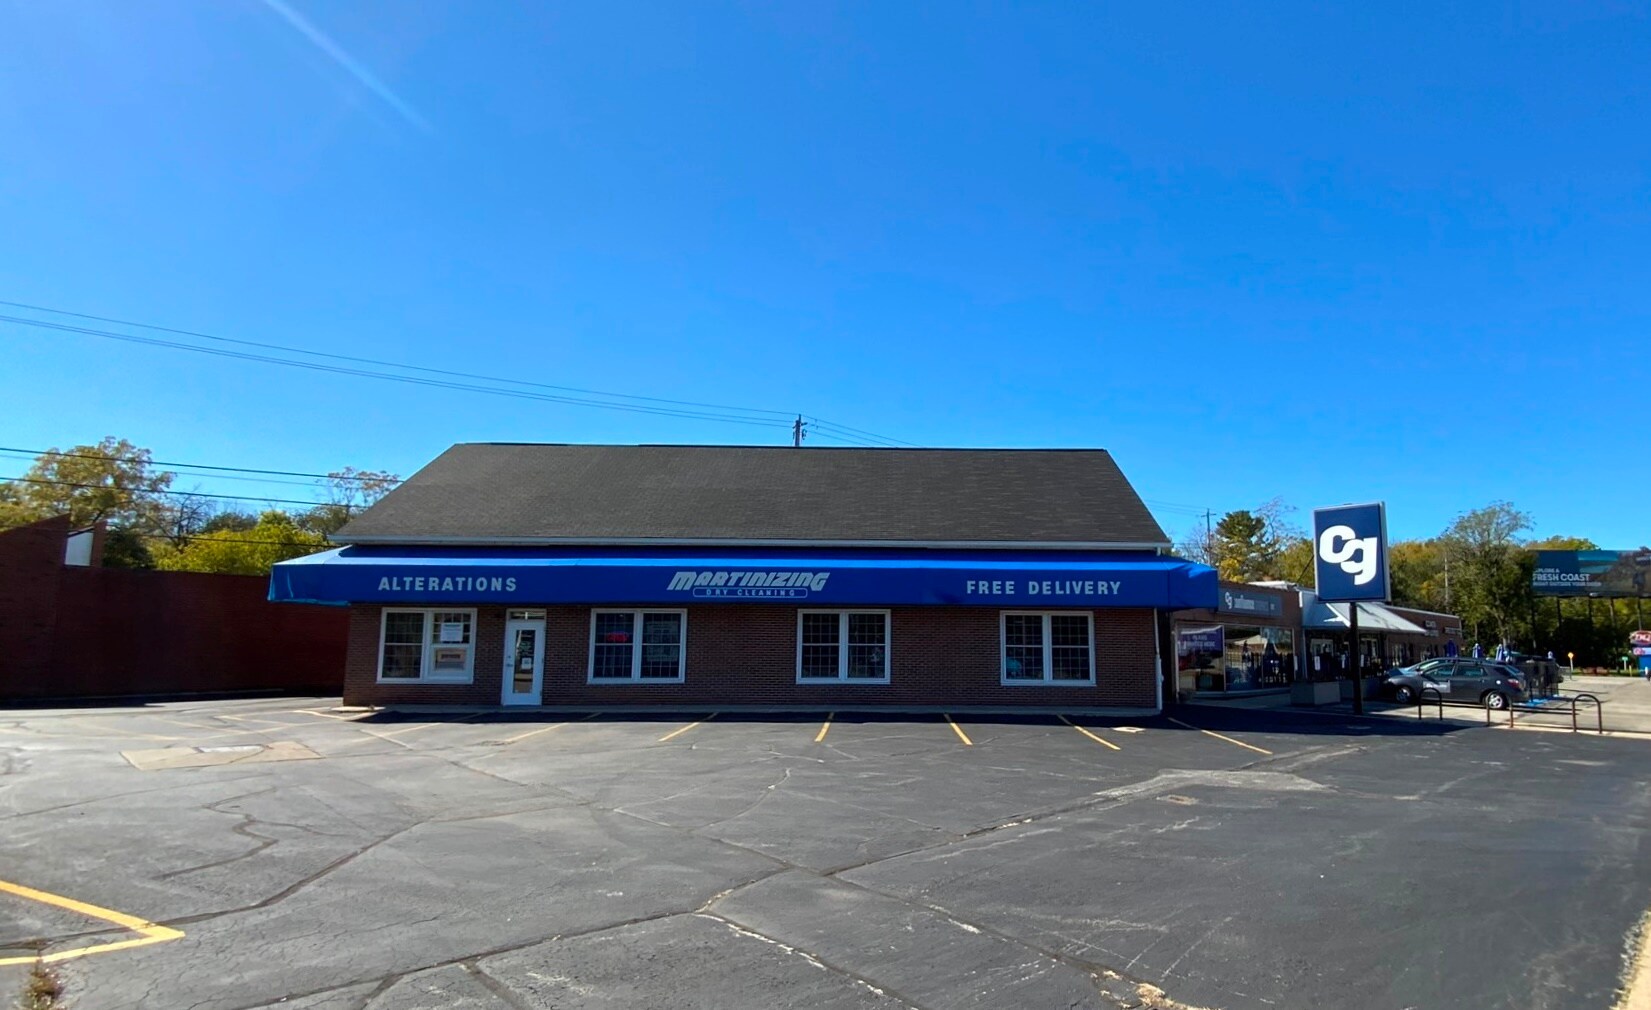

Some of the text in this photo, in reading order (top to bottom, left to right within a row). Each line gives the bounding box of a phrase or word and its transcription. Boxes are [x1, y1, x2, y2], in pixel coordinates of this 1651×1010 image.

[377, 576, 518, 592] ALTERATIONS
[666, 571, 830, 591] MARTINIZING
[1532, 573, 1560, 581] FRESH
[737, 589, 796, 597] CLEANING
[966, 580, 1121, 595] FREE DELIVERY
